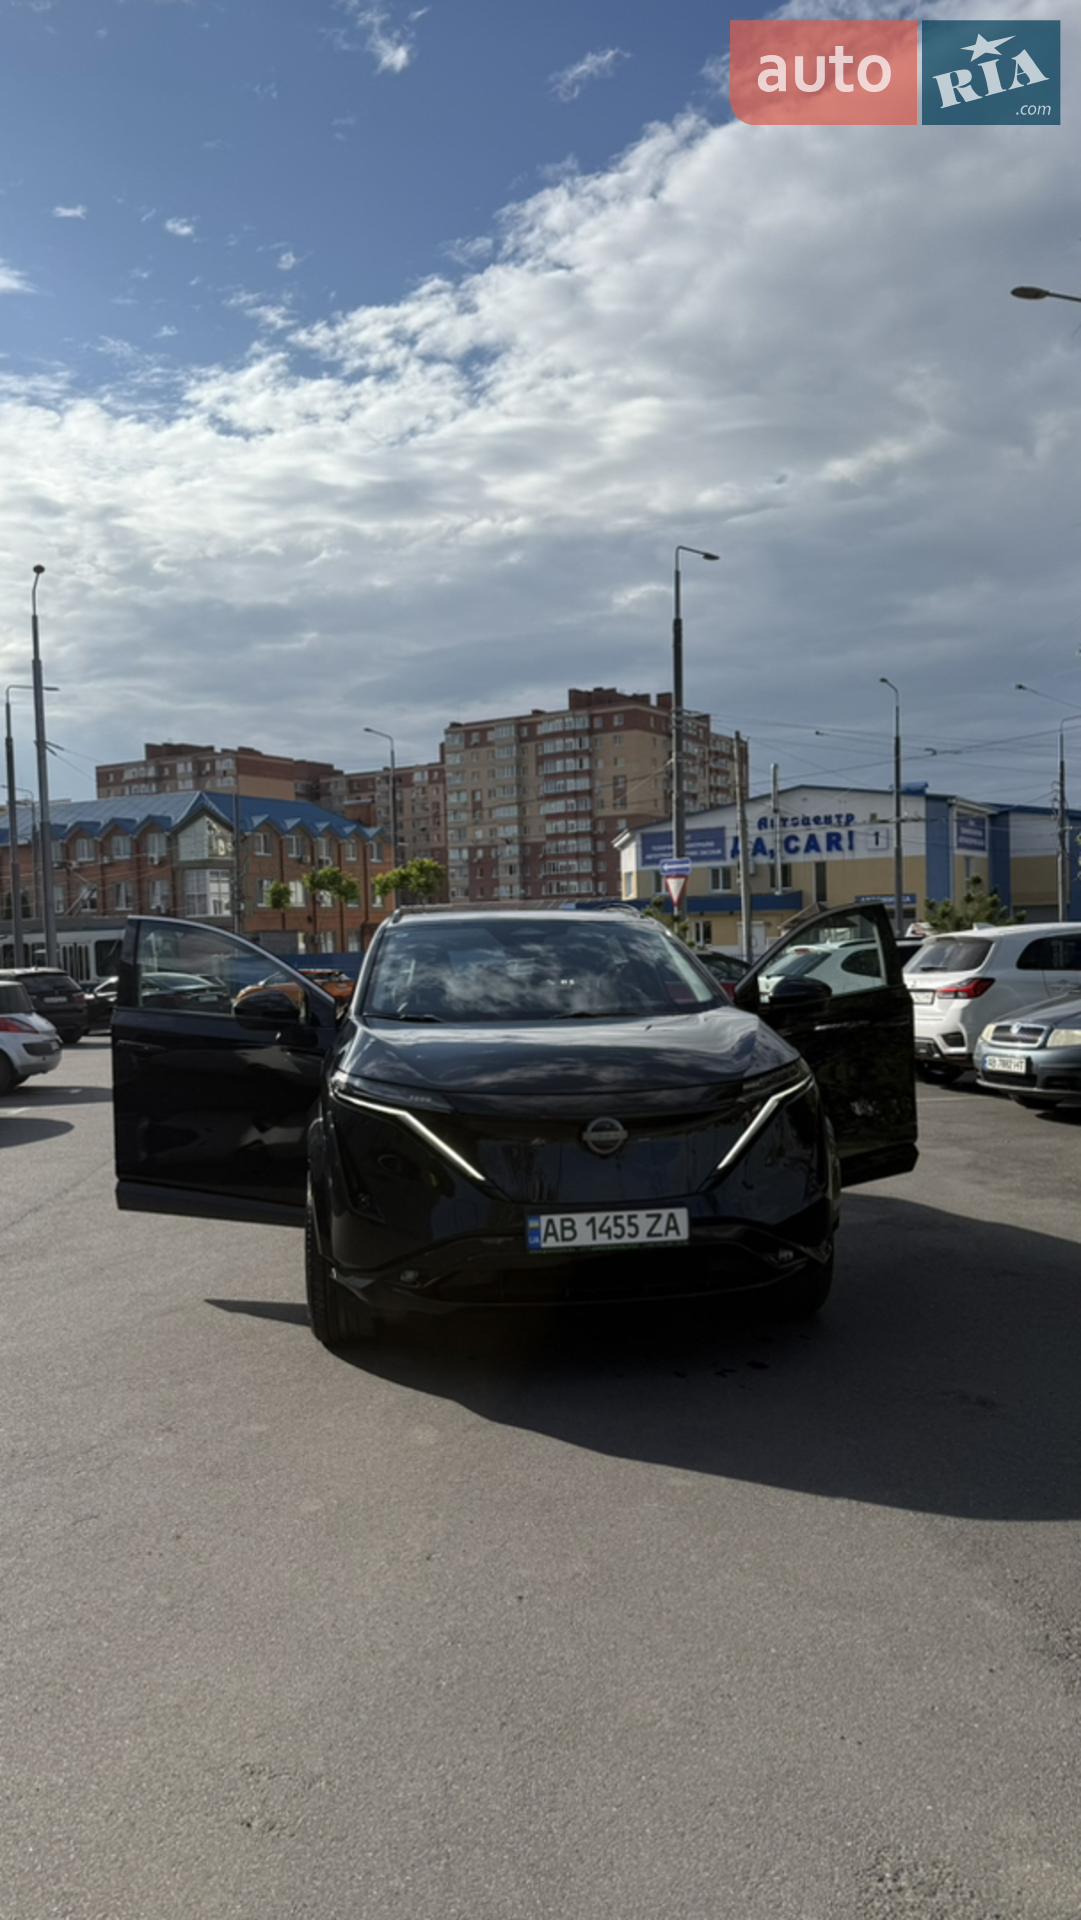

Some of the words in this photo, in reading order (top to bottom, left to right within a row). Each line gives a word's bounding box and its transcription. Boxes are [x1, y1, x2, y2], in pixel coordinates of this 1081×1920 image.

[783, 830, 854, 854] CAR!
[872, 831, 880, 847] 1
[543, 1217, 578, 1244] AB
[585, 1214, 640, 1241] 1455
[645, 1212, 681, 1238] ZA
